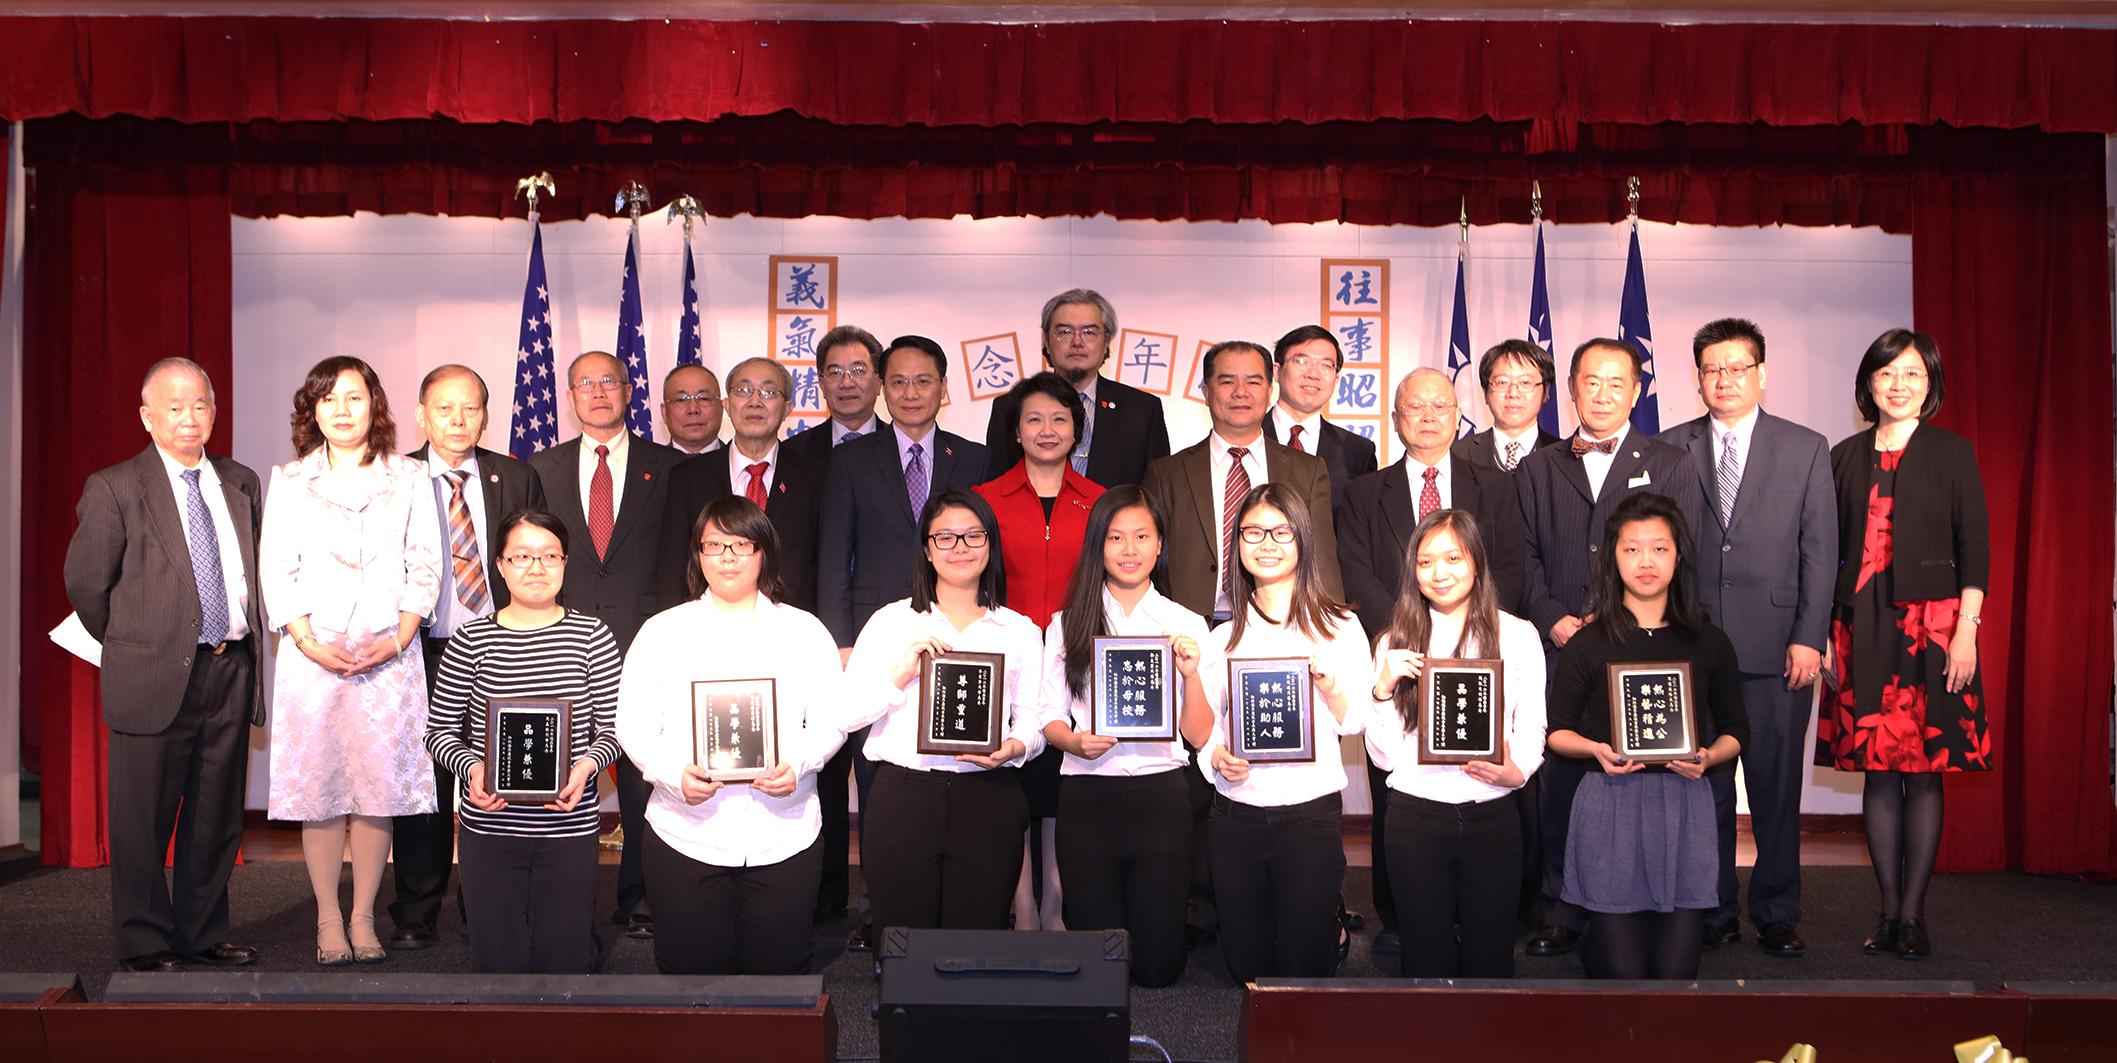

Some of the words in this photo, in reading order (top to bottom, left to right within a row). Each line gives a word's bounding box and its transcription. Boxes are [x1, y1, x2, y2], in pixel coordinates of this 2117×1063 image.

[971, 344, 1015, 390] 念
[1124, 337, 1168, 385] 年
[954, 674, 968, 731] 尊師重道
[521, 724, 534, 780] 品學兼優
